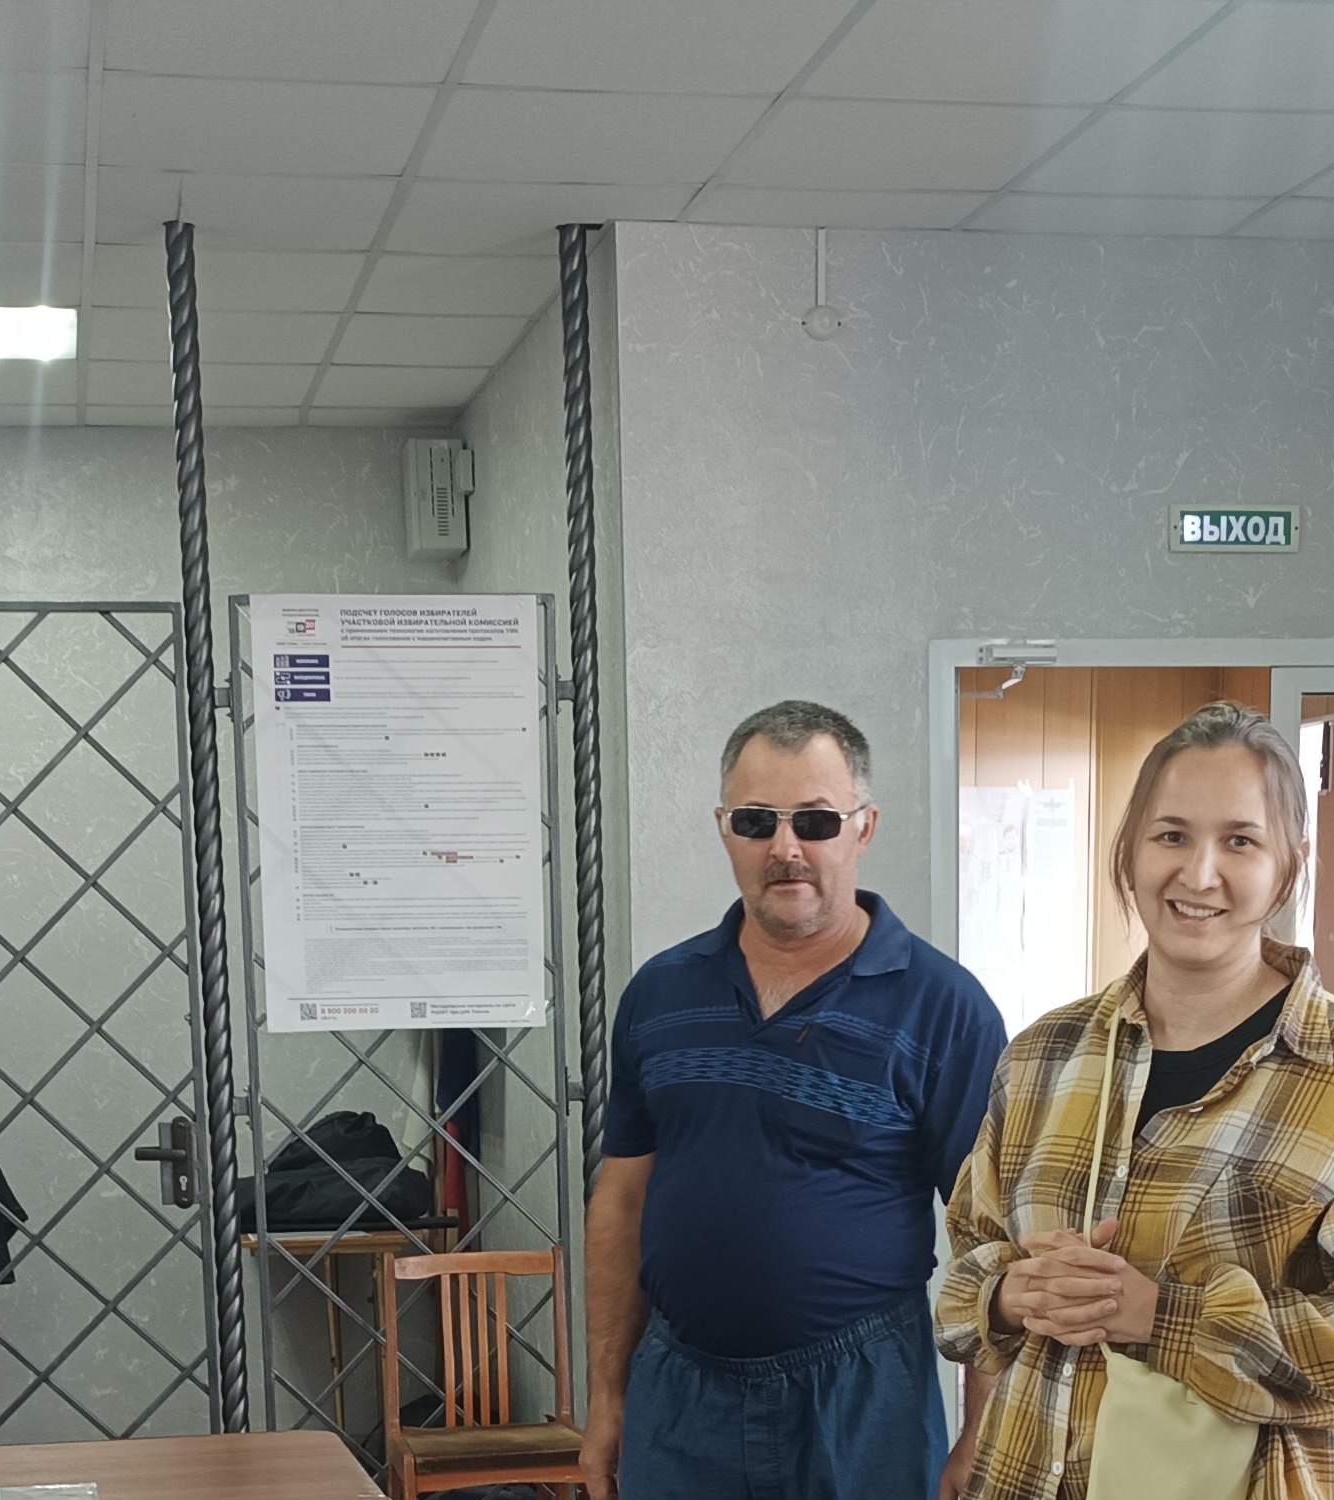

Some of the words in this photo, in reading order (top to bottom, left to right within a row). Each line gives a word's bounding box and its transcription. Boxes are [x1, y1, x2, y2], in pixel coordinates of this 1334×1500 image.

[1183, 514, 1286, 545] ВЫХОД
[339, 609, 378, 617] ПОДСЧЕТ
[379, 609, 418, 617] ГОЛОСОВ
[419, 607, 478, 617] ИЗБИРАТЕЛЕЙ
[340, 618, 396, 626] УЧАСТКОВОЙ
[397, 617, 467, 626] ИЗБИРАТЕЛЬНОЙ
[468, 617, 519, 626] КОМИССИЕЙ
